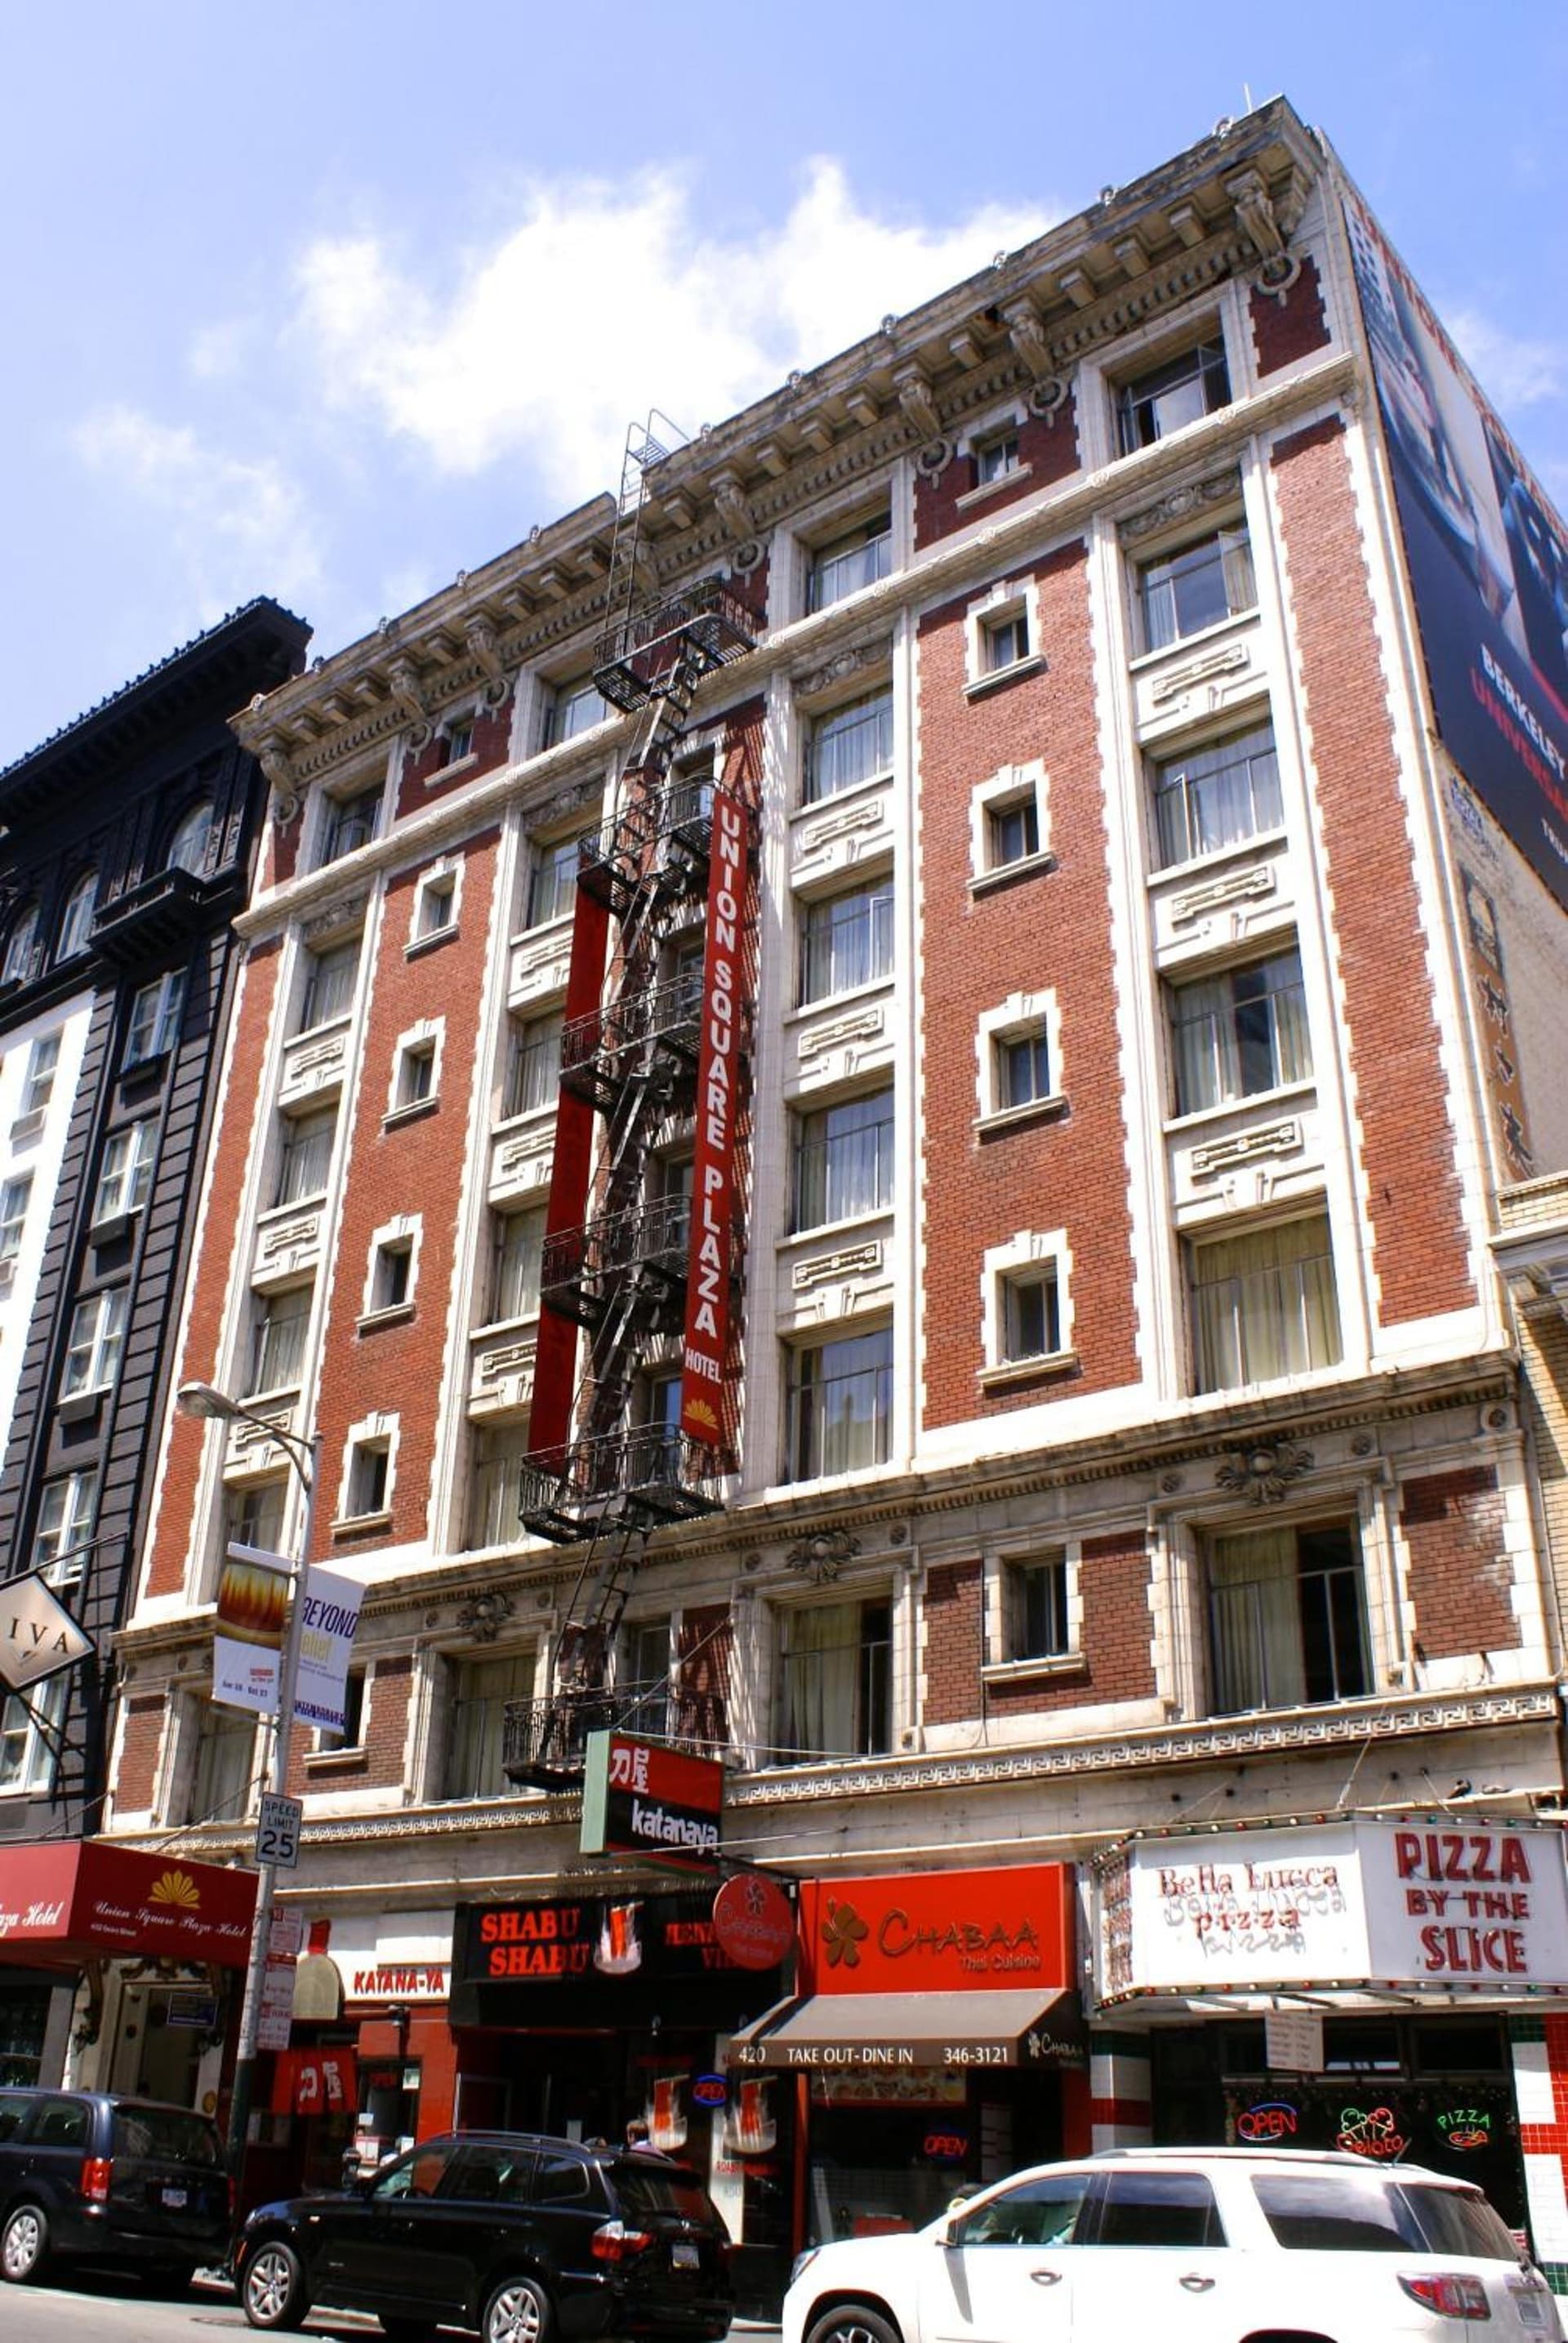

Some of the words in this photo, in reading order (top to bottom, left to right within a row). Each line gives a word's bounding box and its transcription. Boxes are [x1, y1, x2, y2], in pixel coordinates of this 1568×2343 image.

[1481, 642, 1566, 781] BERKELEY
[715, 805, 740, 953] UNION
[706, 960, 733, 1151] SQUARE
[694, 1164, 724, 1339] PLAZA
[685, 1347, 722, 1385] HOTEL
[609, 1747, 651, 1795] 刀屋
[264, 1800, 299, 1818] SPEED
[267, 1815, 294, 1829] LIMIT
[631, 1798, 719, 1855] katanaya
[261, 1830, 294, 1858] 25
[1395, 1833, 1532, 1883] PIZZA
[21, 1902, 65, 1933] Hotel
[92, 1901, 131, 1918] Union
[136, 1907, 175, 1927] Square
[179, 1915, 212, 1935] Plaza
[215, 1922, 247, 1938] Hotel
[1406, 1889, 1449, 1917] BY
[1462, 1891, 1530, 1920] THE
[481, 1909, 581, 1942] SHABU
[878, 1907, 1038, 1958] CHABAA
[489, 1944, 590, 1976] SHABU
[961, 1954, 987, 1973] Thai
[993, 1953, 1040, 1970] Cuisine
[1420, 1925, 1529, 1973] SLICE
[354, 1967, 443, 1994] KATANA-YA
[738, 2046, 766, 2064] 420
[786, 2047, 819, 2064] TAKE
[862, 2047, 895, 2063] DINE
[898, 2047, 914, 2064] IN
[943, 2046, 1009, 2064] 346-3121
[1238, 2111, 1297, 2136] OPEN
[1437, 2109, 1491, 2130] PIZZA
[924, 2136, 968, 2156] OPEN
[1336, 2132, 1404, 2157] Gelato
